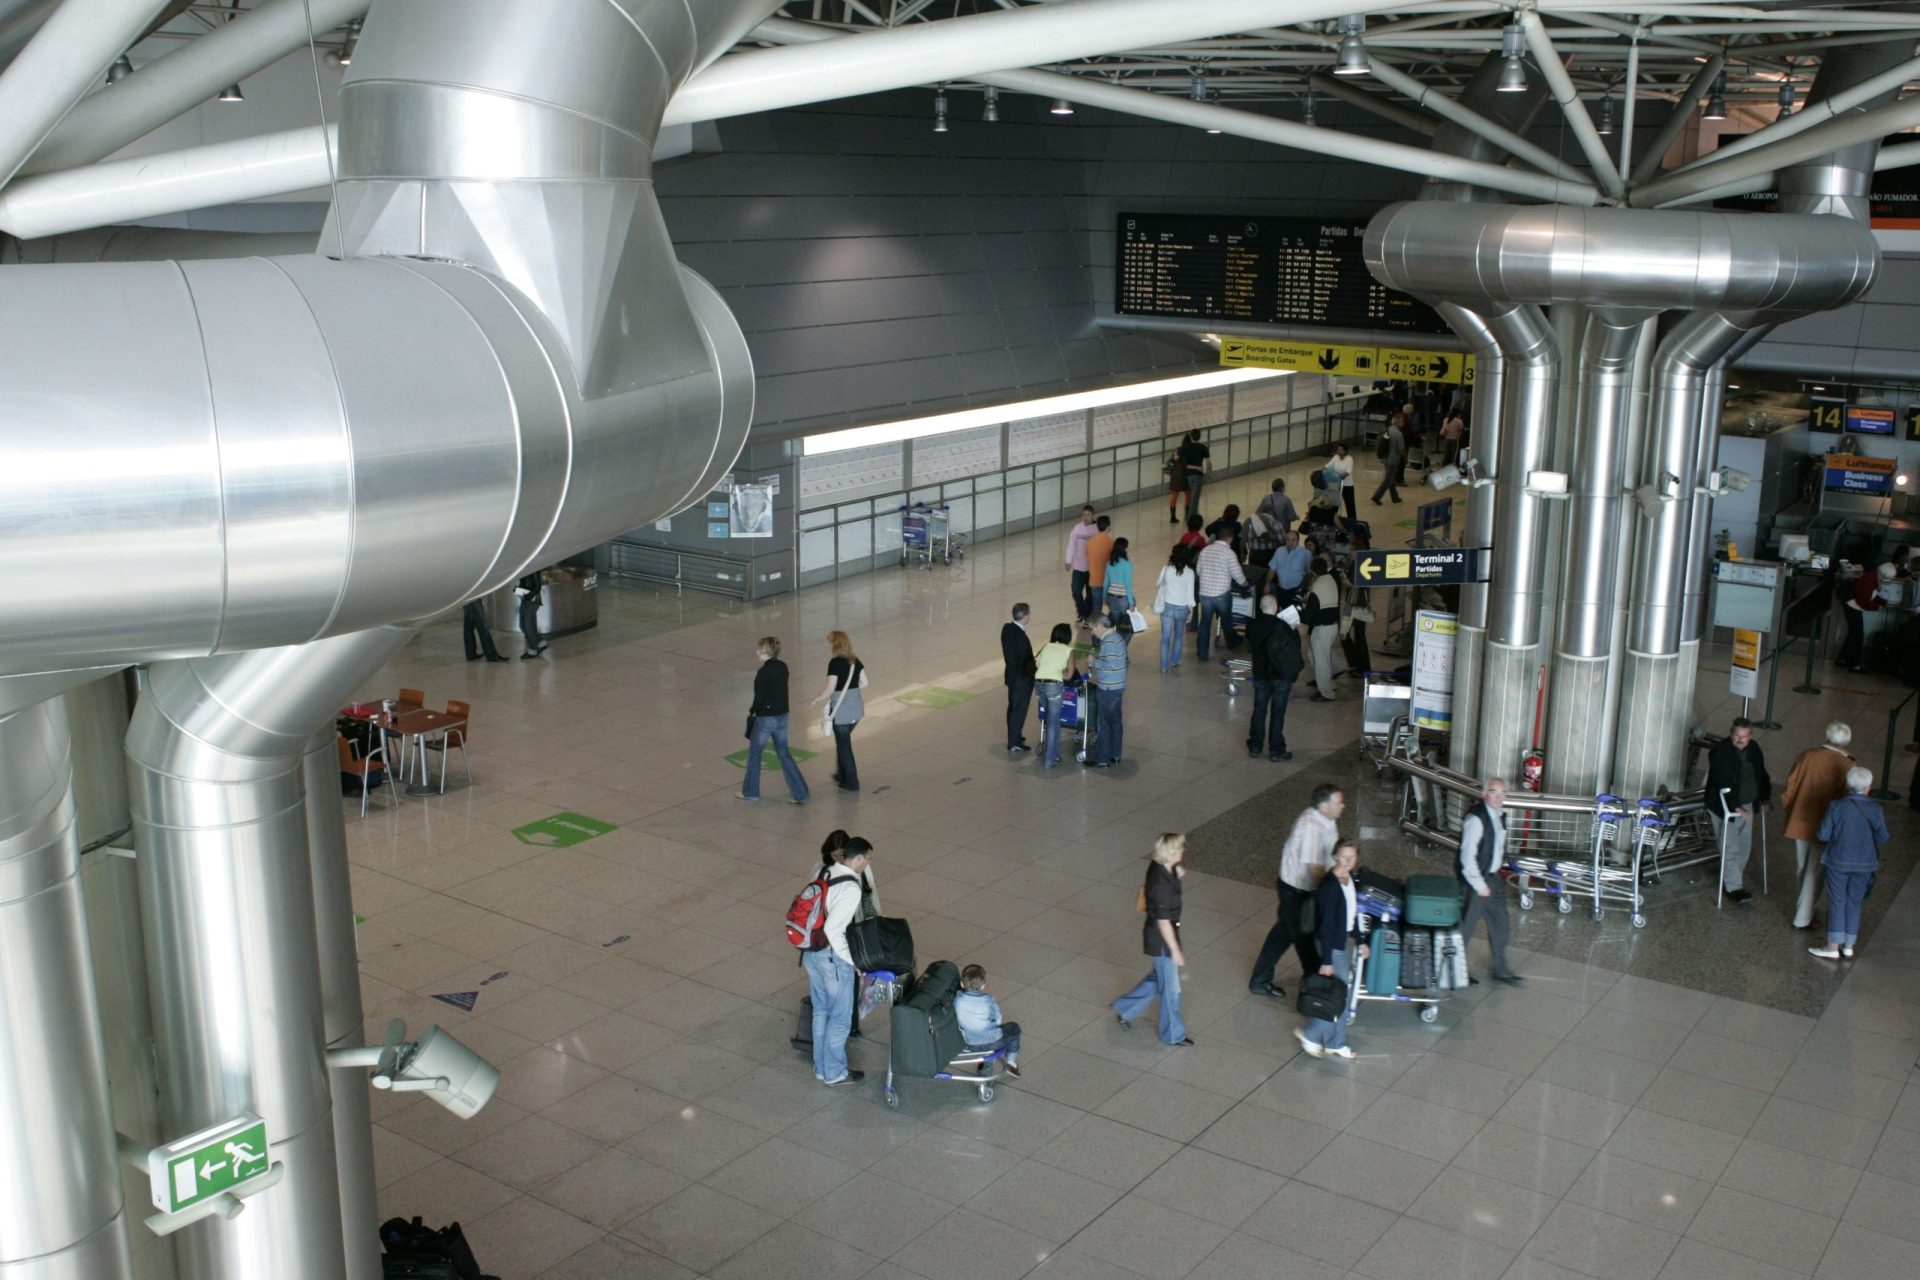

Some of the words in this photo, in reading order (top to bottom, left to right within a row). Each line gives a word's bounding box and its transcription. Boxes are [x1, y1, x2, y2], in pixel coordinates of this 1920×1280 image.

[1246, 344, 1267, 353] Portas
[1279, 347, 1313, 357] Embarque
[1246, 353, 1275, 364] Boarding
[1277, 356, 1296, 364] Gates
[1384, 361, 1400, 375] 14
[1409, 363, 1426, 377] 36
[1813, 406, 1840, 429] 14
[1846, 459, 1893, 470] Lufthansa
[1844, 470, 1884, 482] Business
[1843, 479, 1868, 489] Class
[1414, 553, 1455, 564] Terminal
[1456, 553, 1464, 563] 2
[1415, 565, 1443, 573] Partidas
